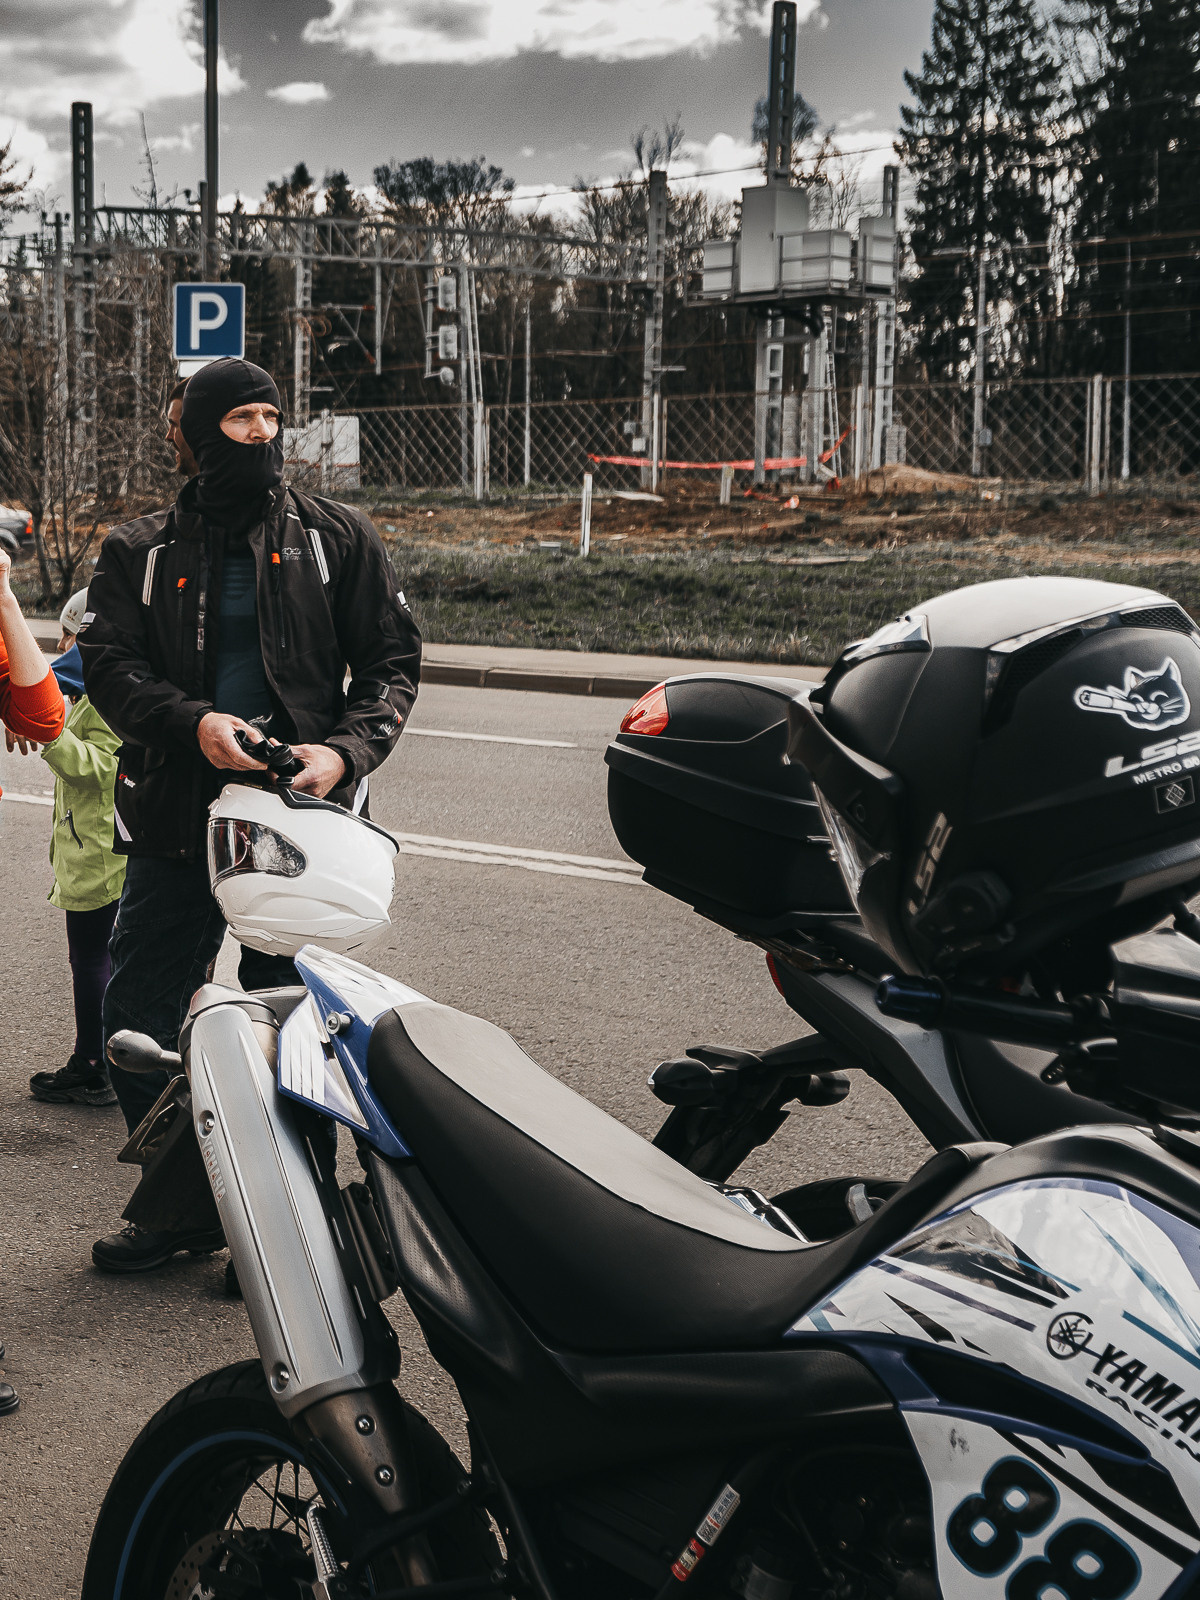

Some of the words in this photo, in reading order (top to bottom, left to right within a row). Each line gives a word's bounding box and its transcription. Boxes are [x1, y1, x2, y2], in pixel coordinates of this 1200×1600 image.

[190, 292, 228, 350] P
[1104, 731, 1200, 778] LS2
[1132, 761, 1182, 785] METRO
[907, 811, 953, 916] LS2
[202, 1137, 227, 1204] YAMAHA
[1092, 1343, 1200, 1444] YAMA
[946, 1455, 1142, 1600] 88
